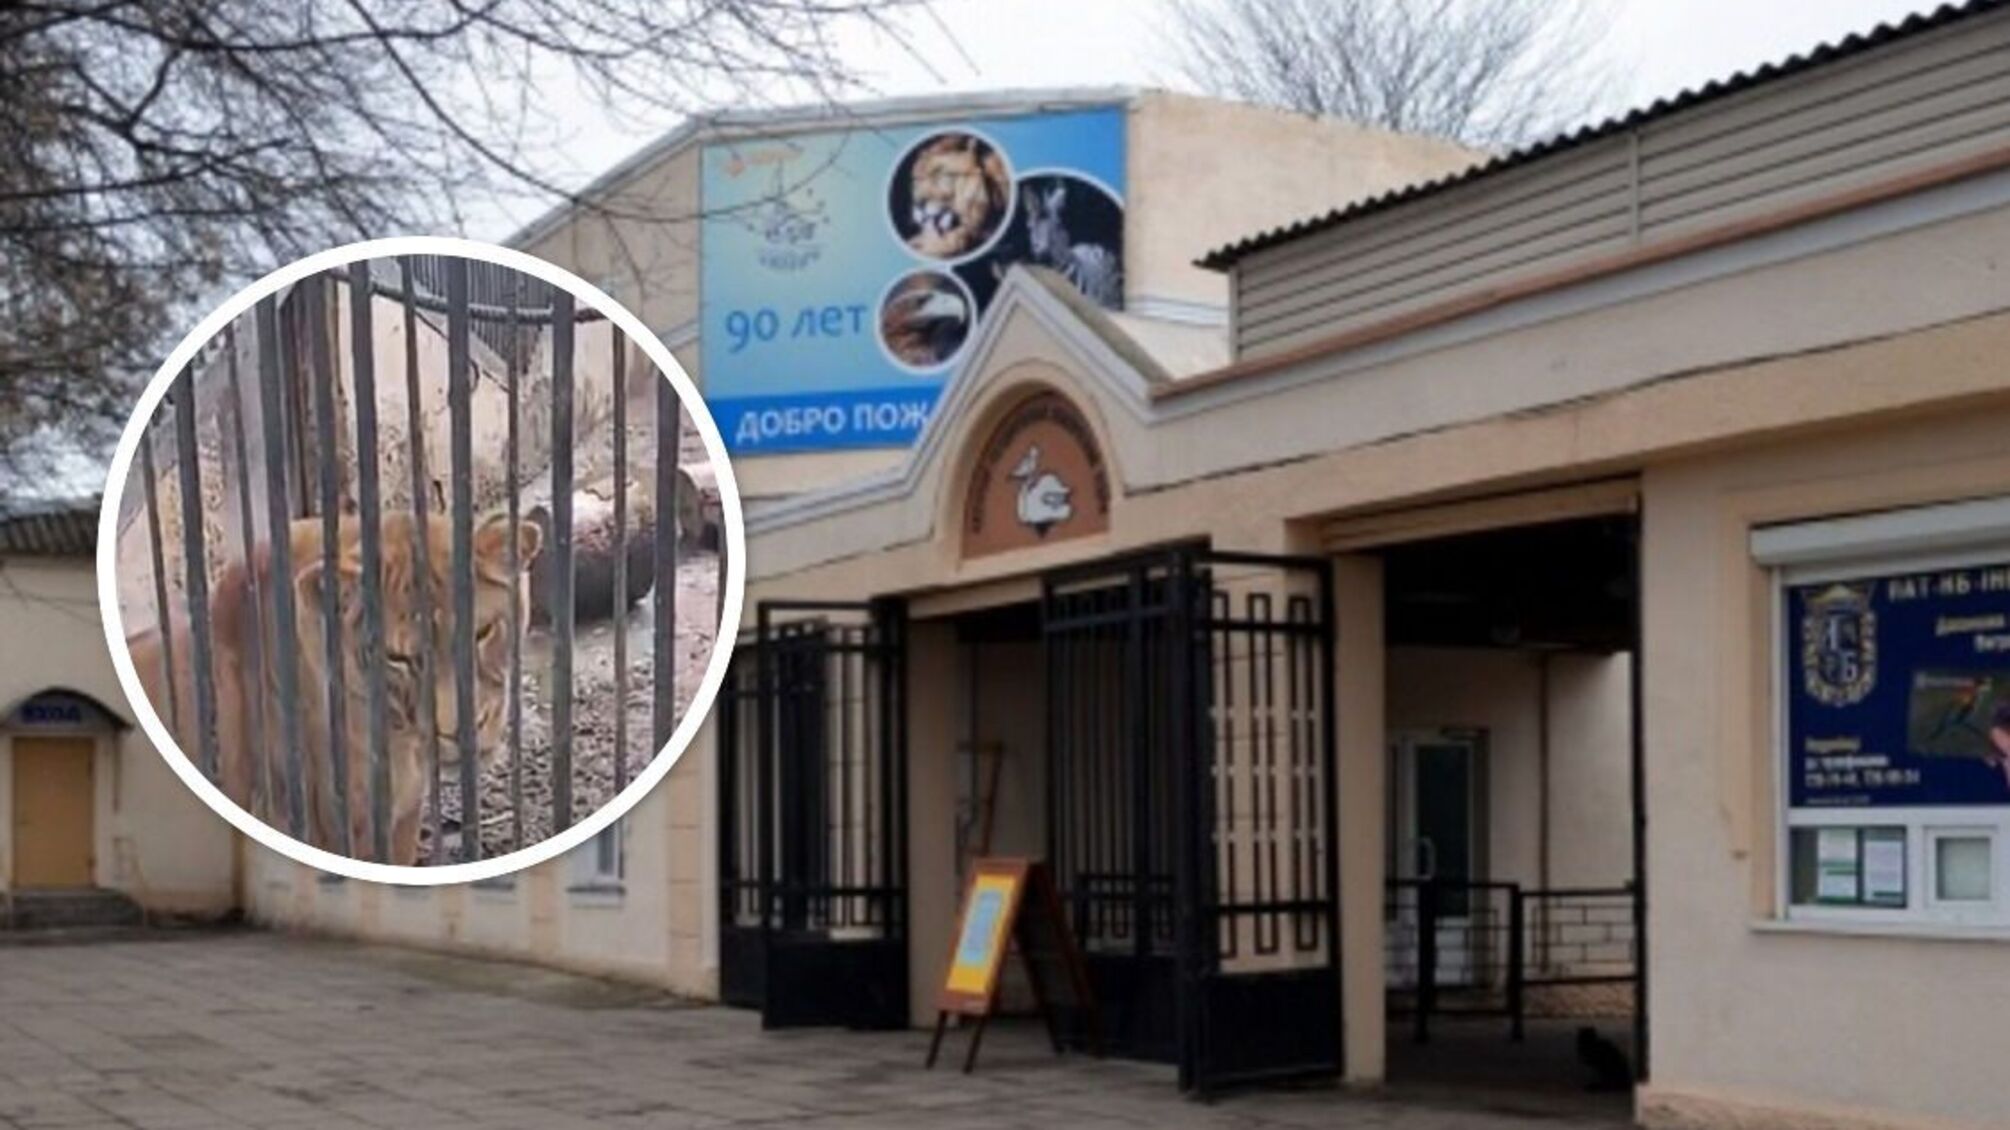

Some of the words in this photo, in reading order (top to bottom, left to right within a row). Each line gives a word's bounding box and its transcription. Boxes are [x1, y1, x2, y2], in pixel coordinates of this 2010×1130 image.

[725, 307, 780, 354] 90
[791, 304, 868, 338] лет
[735, 405, 848, 446] ДОБРО
